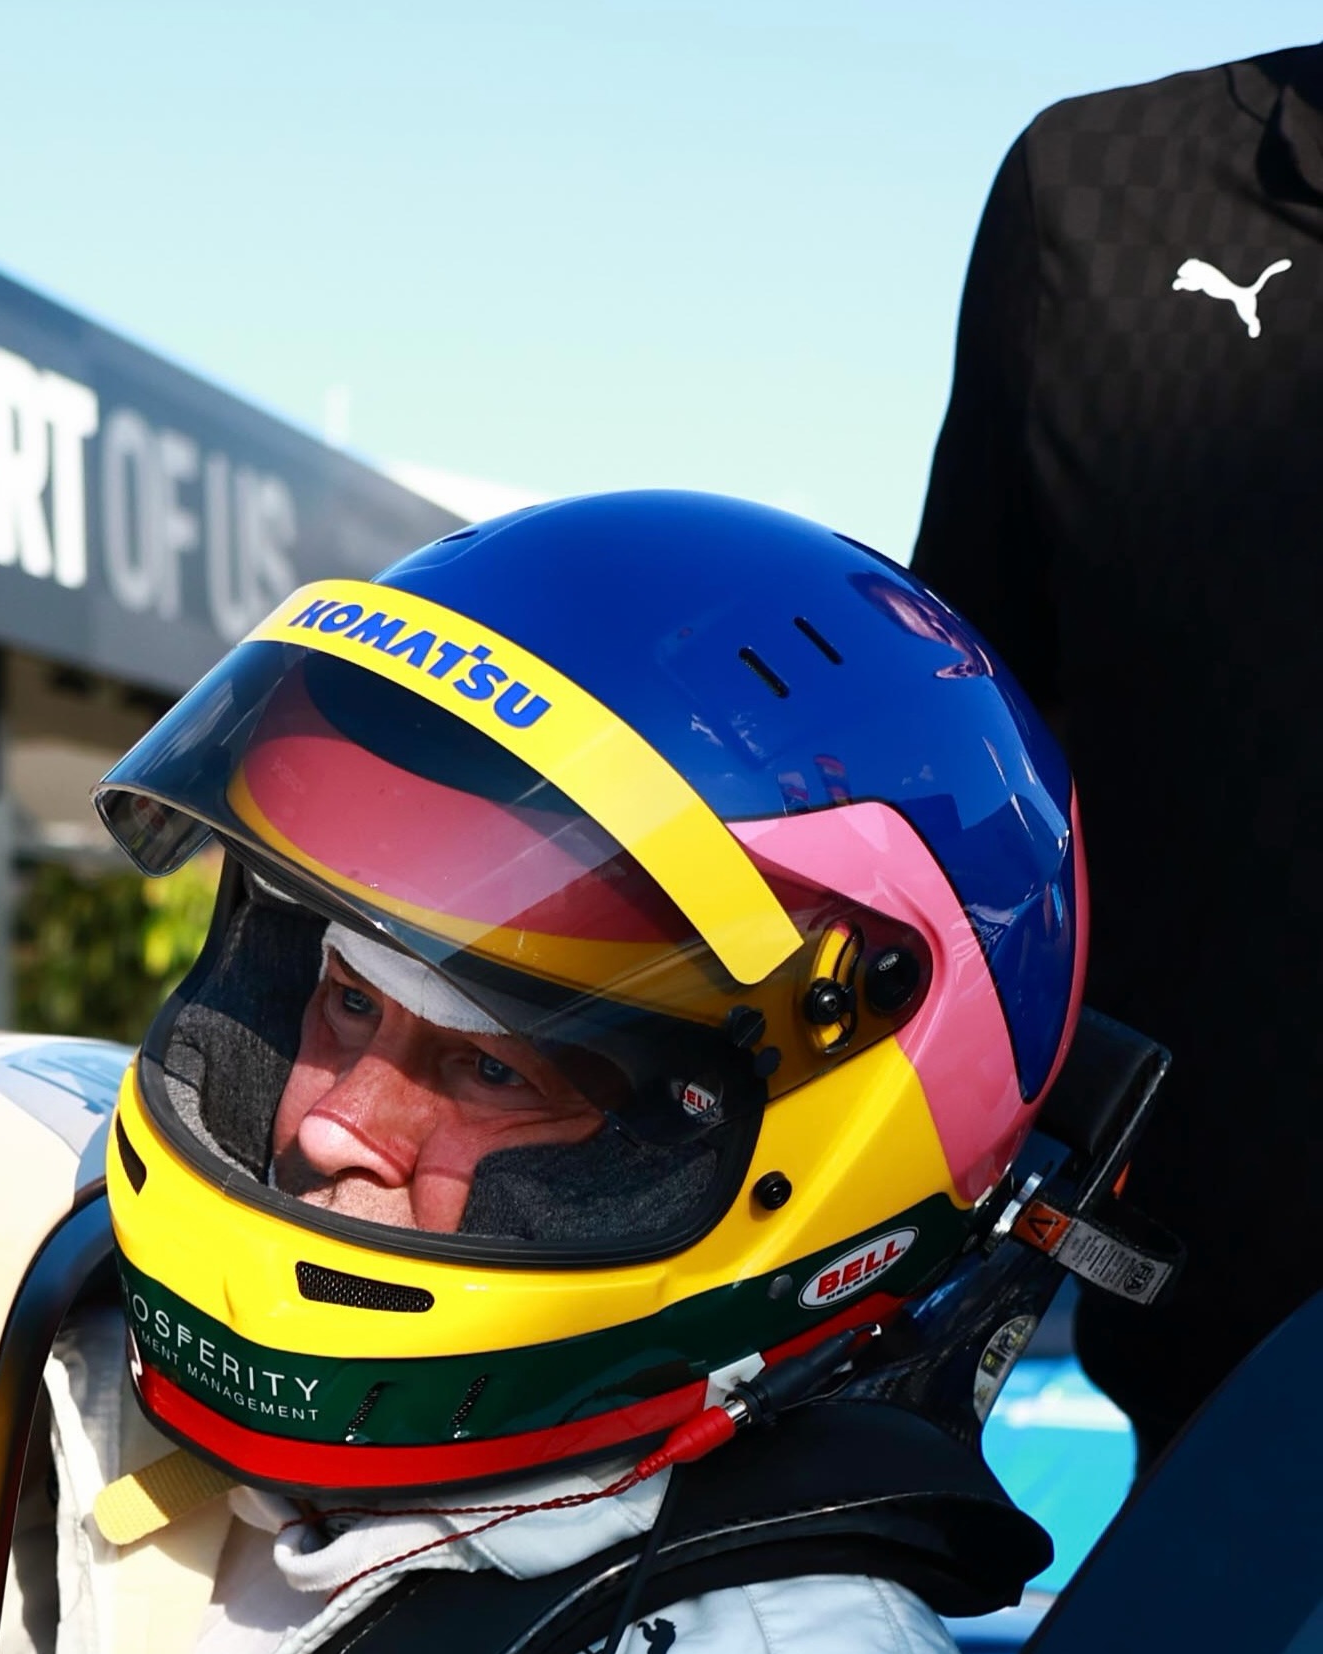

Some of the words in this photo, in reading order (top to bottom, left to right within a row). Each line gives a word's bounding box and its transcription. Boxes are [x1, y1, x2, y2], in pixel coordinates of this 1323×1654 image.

[102, 406, 203, 618] OF
[203, 448, 301, 644] US
[288, 599, 553, 729] KOMATSU
[816, 1239, 899, 1299] BELL
[187, 1362, 319, 1421] MANAGEMENT
